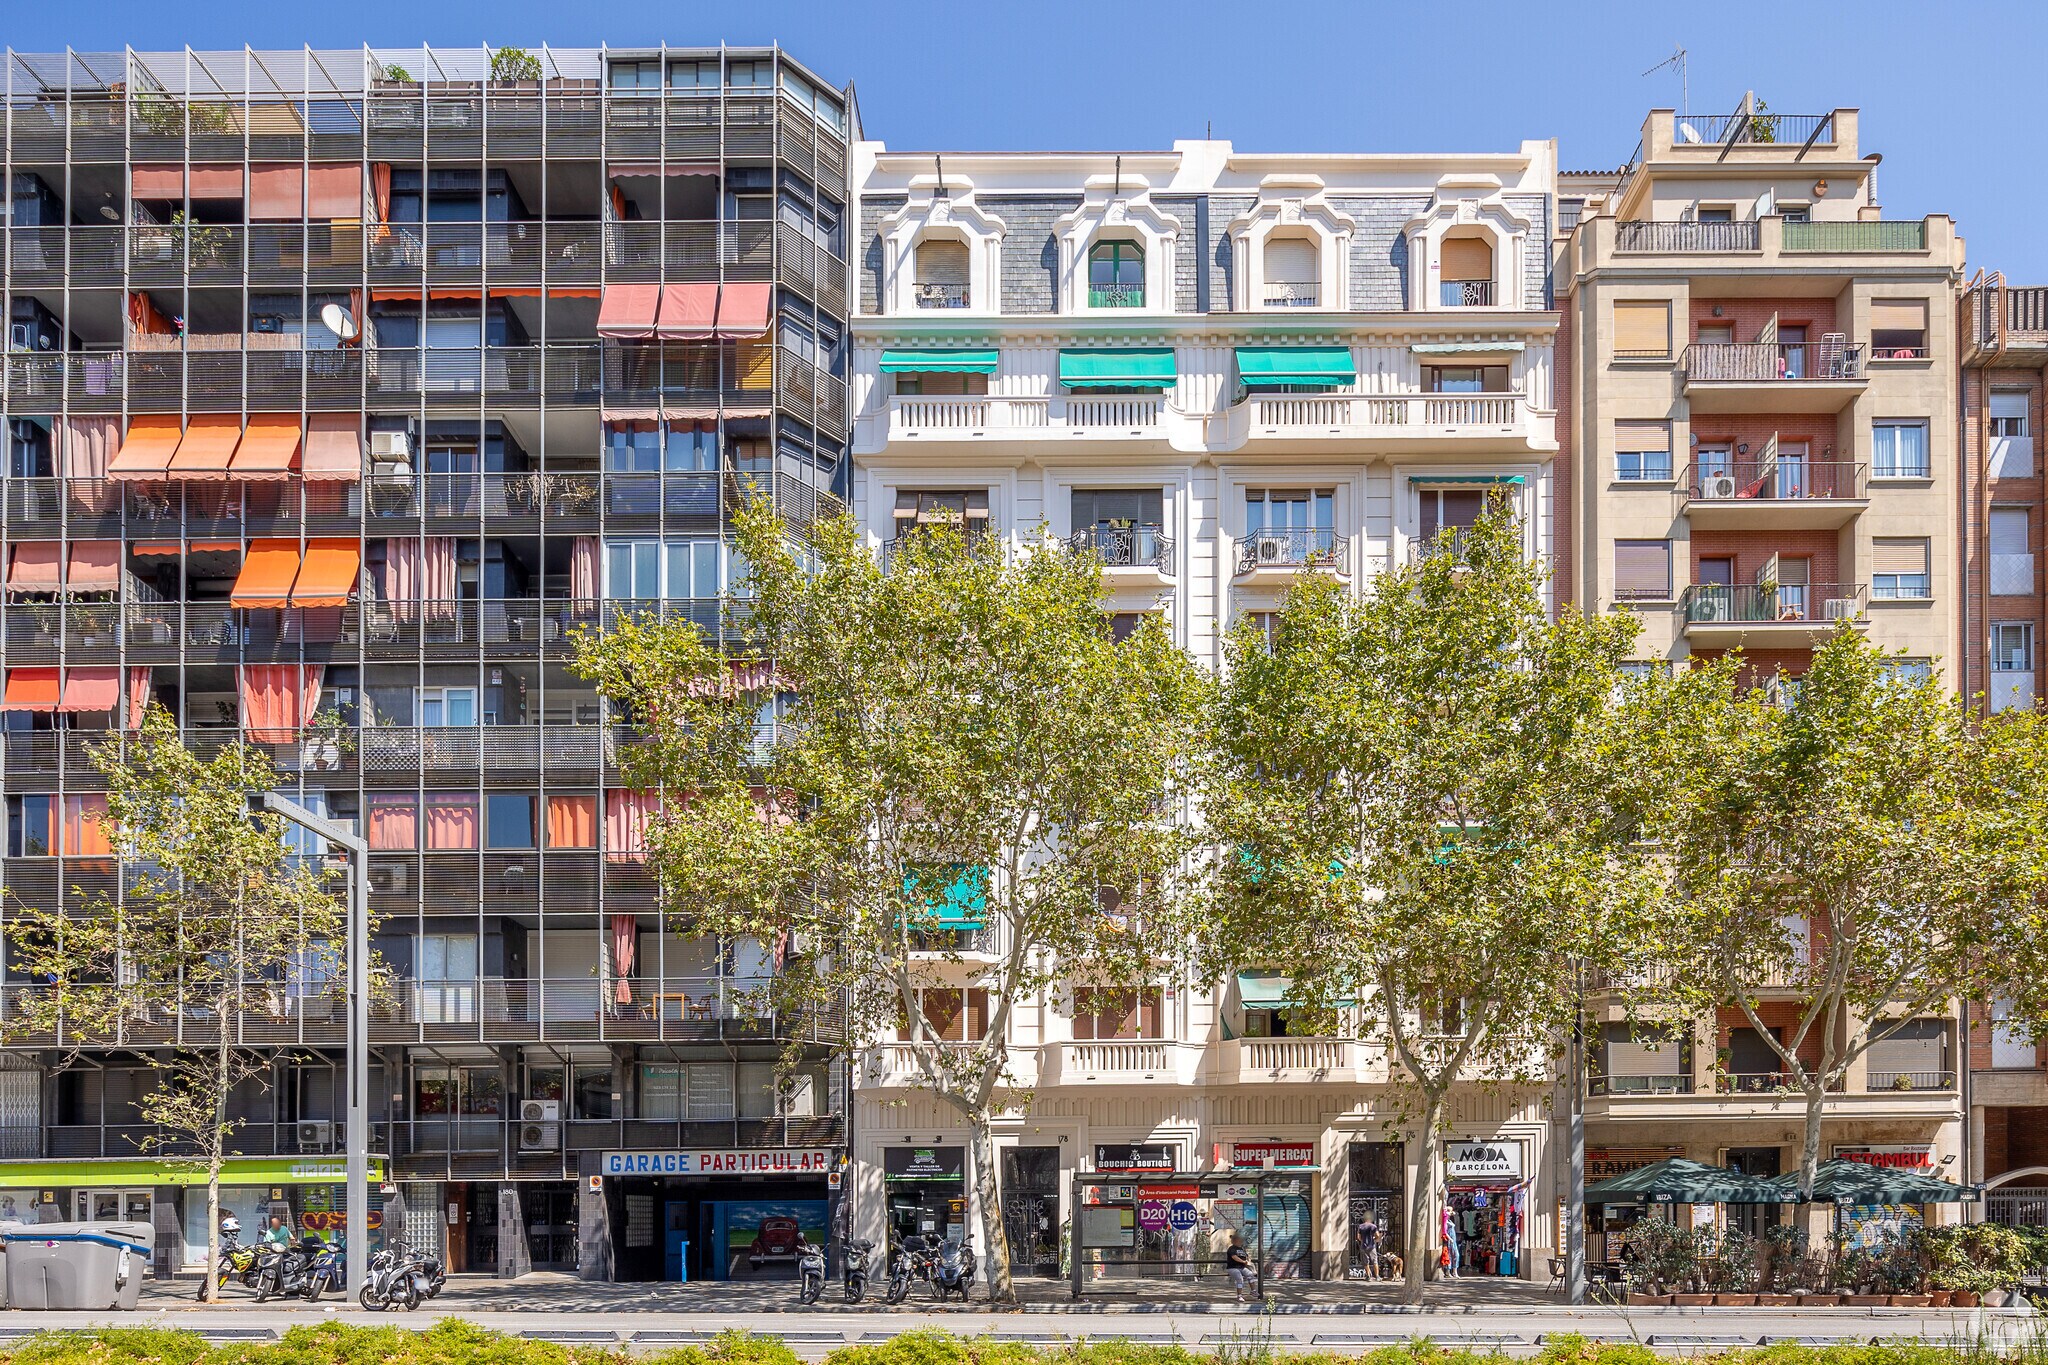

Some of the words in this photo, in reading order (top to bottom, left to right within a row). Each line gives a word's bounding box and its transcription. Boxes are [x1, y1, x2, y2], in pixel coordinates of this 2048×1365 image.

[1058, 1135, 1069, 1144] 178
[1459, 1147, 1508, 1162] MODA
[610, 1154, 690, 1172] GARAGE
[700, 1152, 825, 1172] PARTICULAR
[1137, 1160, 1172, 1168] BOUTIQUE
[1455, 1163, 1511, 1171] BARCELONA
[1140, 1208, 1167, 1220] D20
[1171, 1209, 1196, 1221] H16
